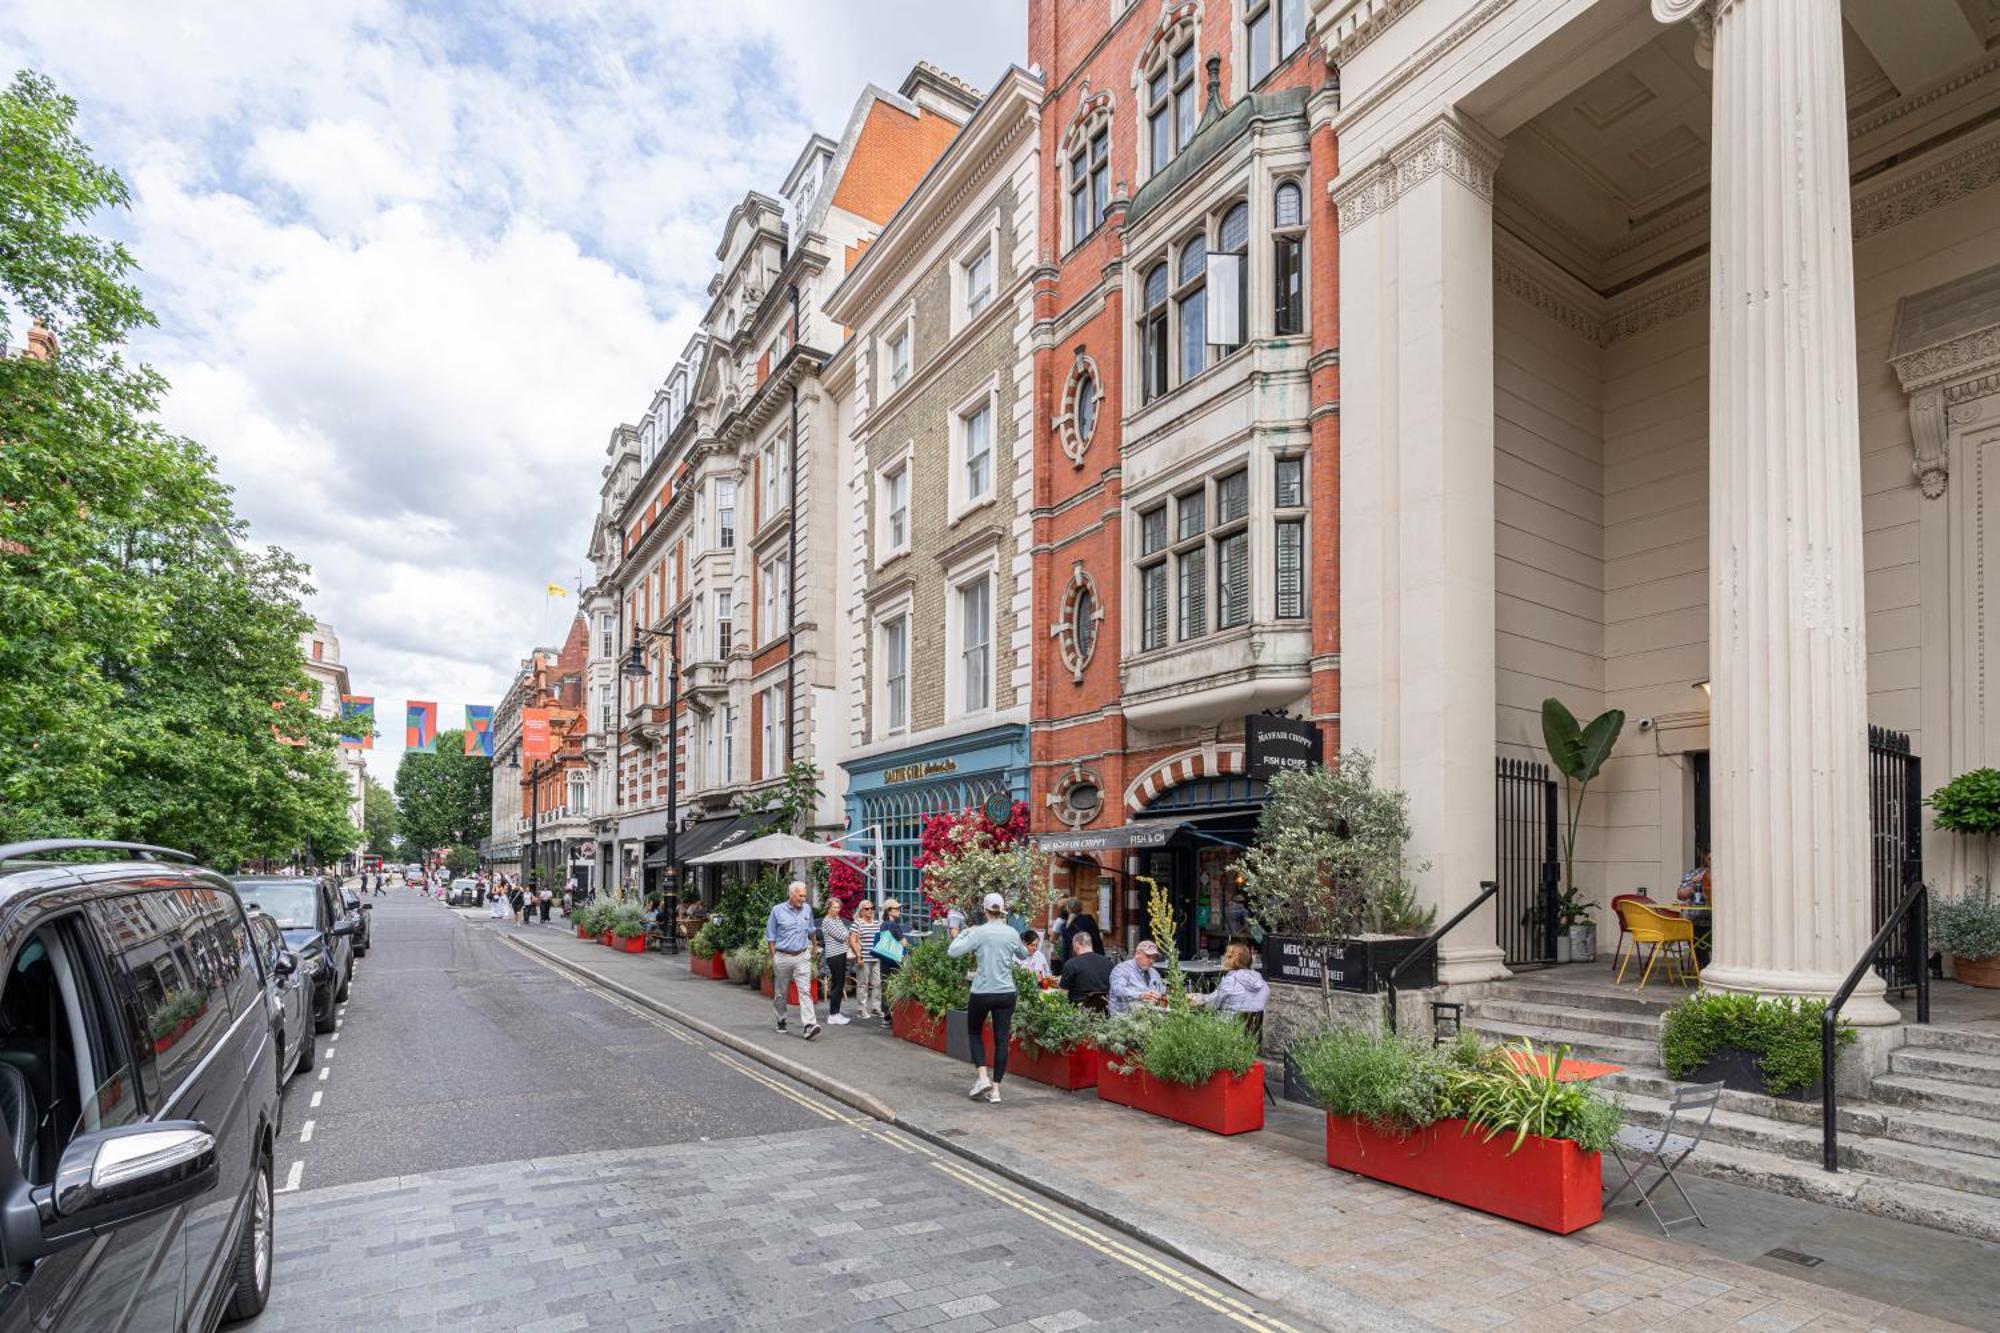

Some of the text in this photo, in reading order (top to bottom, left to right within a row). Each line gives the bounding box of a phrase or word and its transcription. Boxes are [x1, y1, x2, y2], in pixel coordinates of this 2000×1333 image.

[1258, 732, 1287, 743] MAYFAIR
[1264, 756, 1307, 768] FISH & CHIPS
[1130, 834, 1146, 844] FISH
[1147, 833, 1153, 843] &
